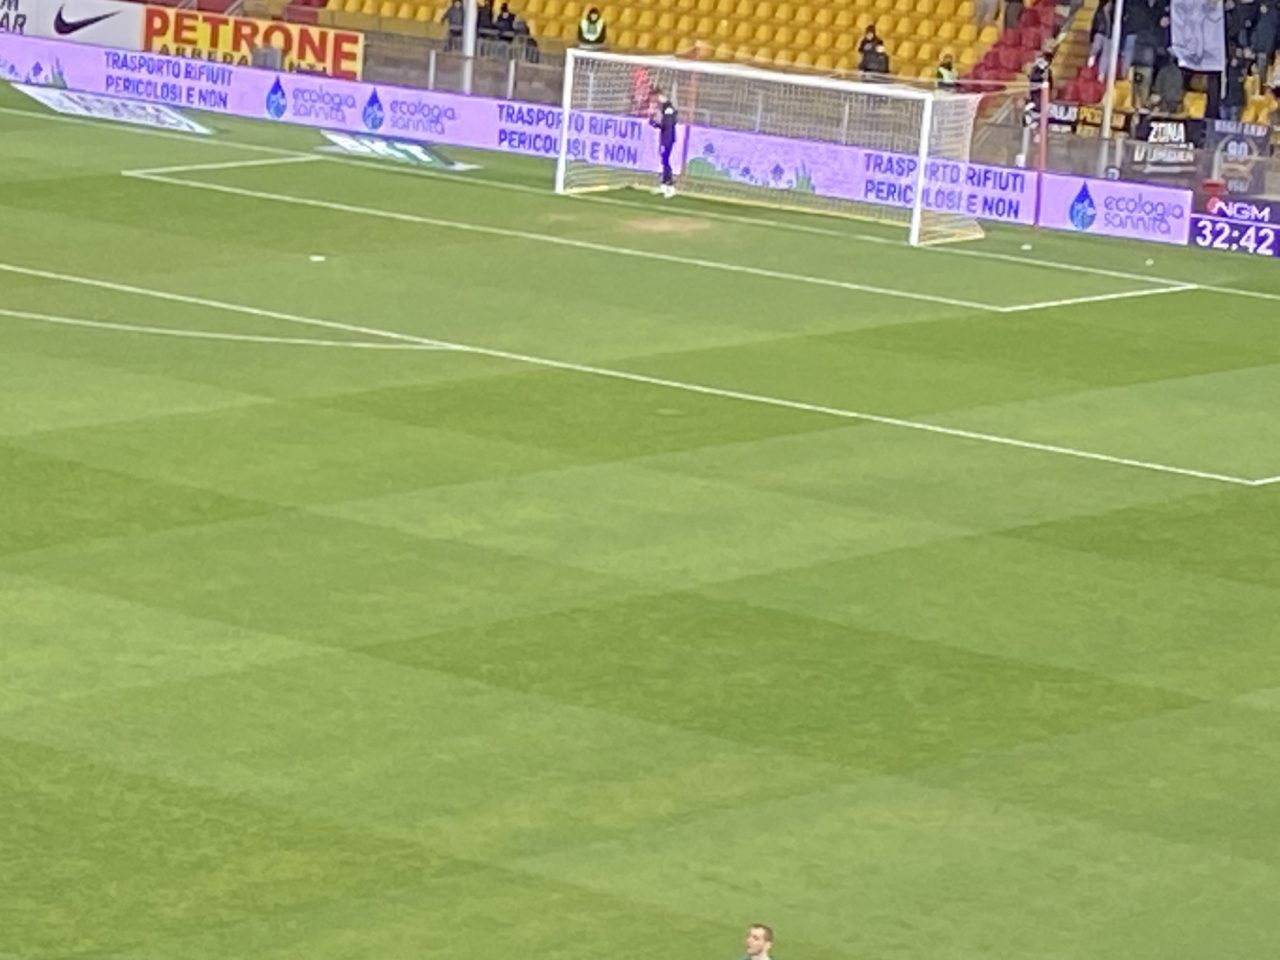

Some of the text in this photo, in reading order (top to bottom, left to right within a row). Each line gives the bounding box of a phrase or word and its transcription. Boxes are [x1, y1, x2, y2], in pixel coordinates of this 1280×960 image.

[144, 8, 359, 81] PETRONE
[104, 51, 180, 78] TRASPORTO
[183, 61, 233, 86] RIFIUTI
[105, 75, 183, 101] PERICOLOSI
[186, 85, 195, 103] E
[198, 89, 228, 109] NON
[589, 115, 643, 140] RIFIUTI
[590, 141, 601, 160] E
[604, 143, 638, 165] NON
[965, 166, 1025, 193] RIFIUTI
[967, 194, 978, 213] E
[982, 195, 1019, 219] NON
[1104, 193, 1186, 221] ecologia
[1211, 200, 1271, 222] NGM
[1196, 219, 1275, 256] 32:42
